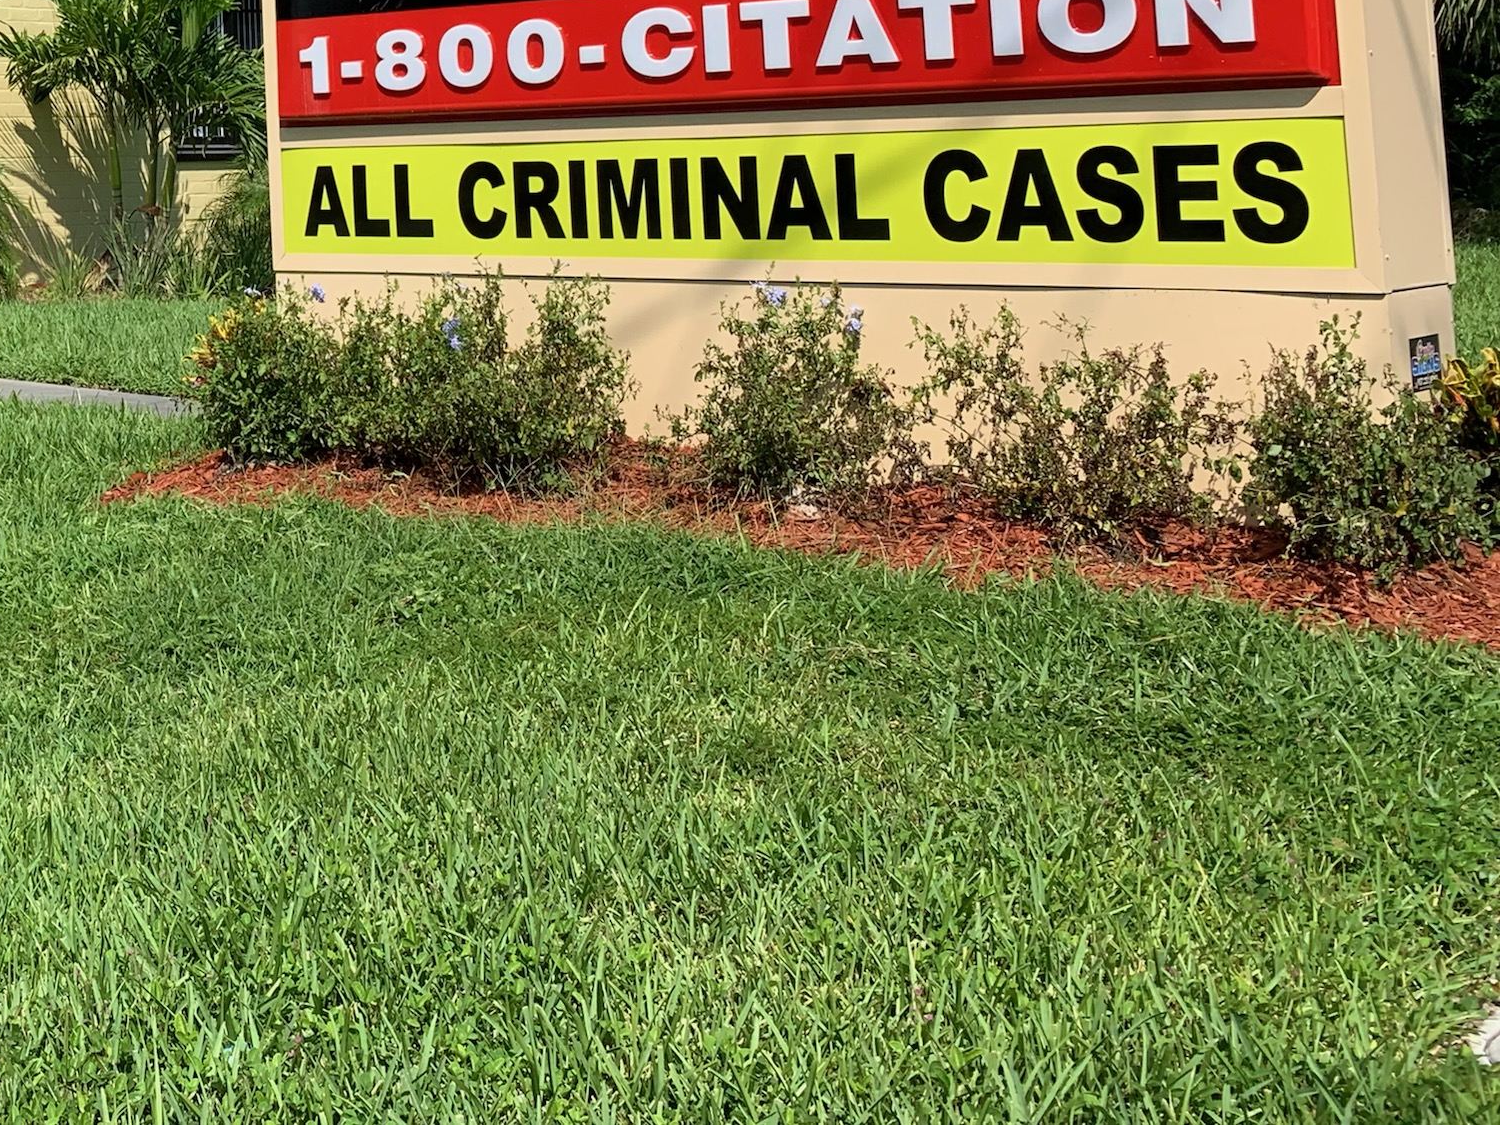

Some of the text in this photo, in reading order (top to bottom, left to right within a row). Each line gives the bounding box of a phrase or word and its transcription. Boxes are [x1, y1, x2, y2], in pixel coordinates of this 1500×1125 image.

[304, 141, 1310, 244] ALL CRIMINAL CASES
